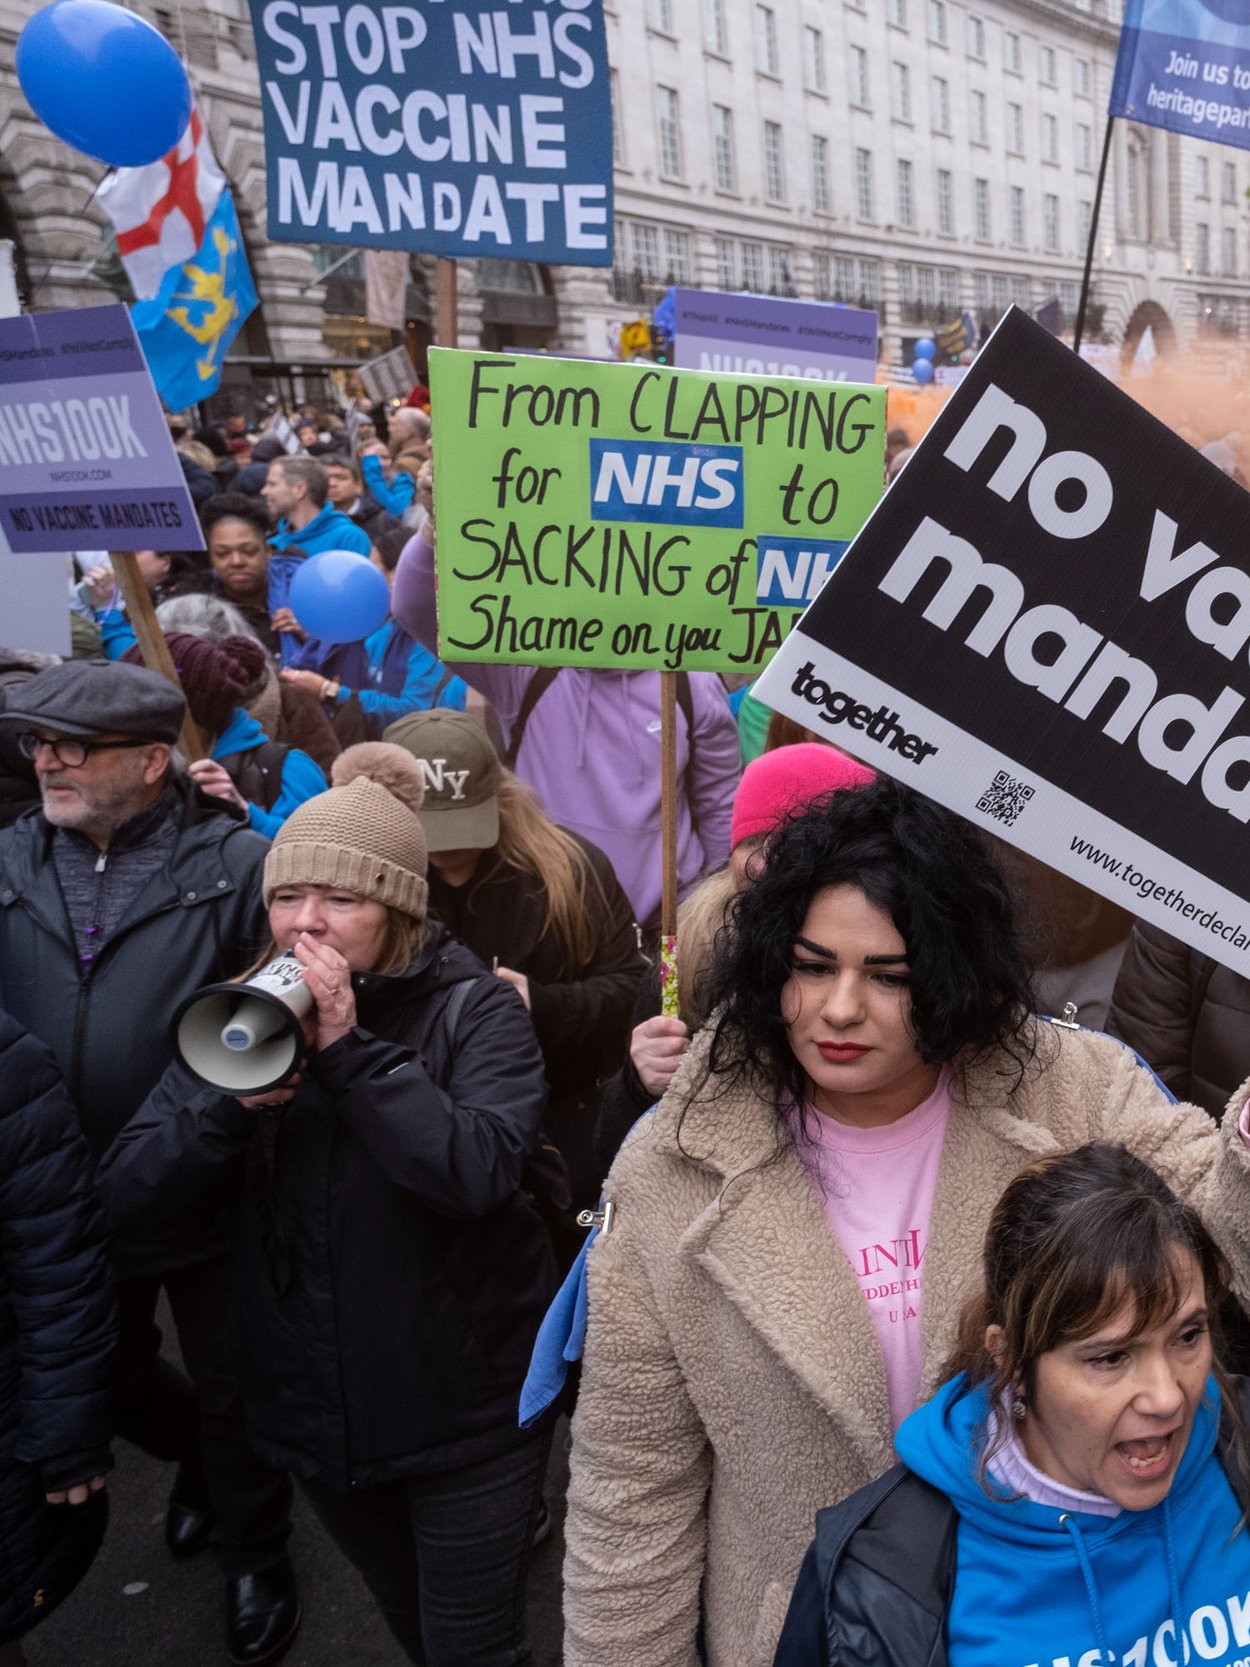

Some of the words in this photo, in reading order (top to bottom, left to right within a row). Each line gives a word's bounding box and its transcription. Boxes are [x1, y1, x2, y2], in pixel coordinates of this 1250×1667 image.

[263, 0, 428, 78] STOP
[453, 11, 595, 89] NHS
[1165, 51, 1198, 79] Join
[1203, 61, 1229, 84] us
[266, 80, 567, 169] VACCINE
[278, 157, 607, 249] MANDATE
[469, 361, 599, 429] From
[629, 372, 875, 454] CLAPPING
[492, 448, 561, 508] for
[594, 452, 740, 510] NHS
[779, 464, 839, 525] to
[944, 384, 1113, 539] no
[9, 507, 34, 532] NO
[32, 504, 99, 531] VACCINE
[99, 502, 182, 529] MANDATES
[452, 519, 691, 597] SACKING
[706, 539, 759, 605] of
[757, 548, 833, 600] NH
[447, 595, 603, 653] Shame
[611, 622, 659, 655] on
[664, 621, 722, 669] you
[728, 608, 803, 664] JA
[791, 661, 939, 765] together
[415, 758, 470, 800] NY
